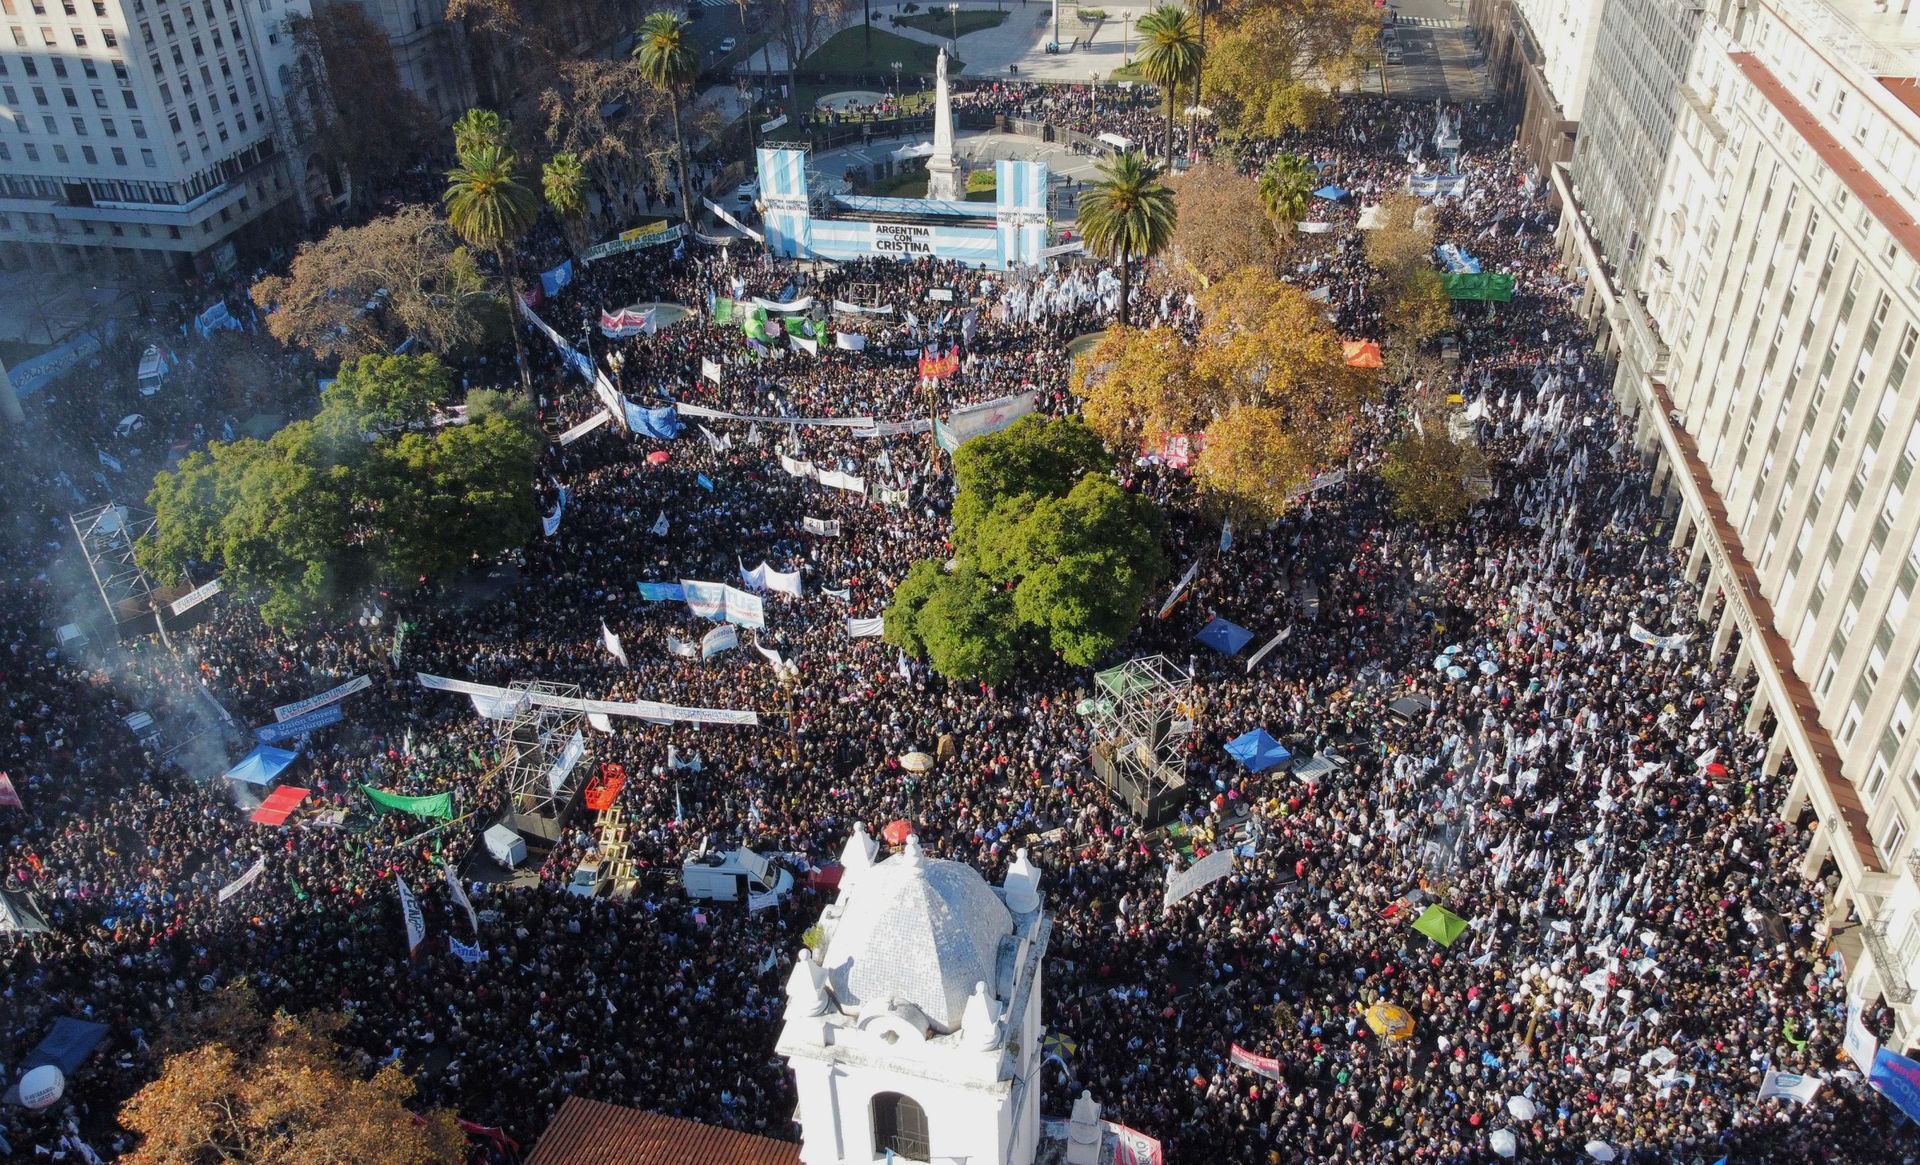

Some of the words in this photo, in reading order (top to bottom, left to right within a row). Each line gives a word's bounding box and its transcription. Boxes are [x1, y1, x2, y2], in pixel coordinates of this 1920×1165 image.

[643, 227, 679, 243] CRISTINA
[876, 225, 929, 237] ARGENTINA
[894, 234, 912, 242] CON
[876, 240, 930, 252] CRISTINA
[1698, 510, 1706, 529] LA
[1706, 528, 1724, 569] FRANCO
[1723, 572, 1753, 637] ARGENTINA
[280, 699, 312, 715] ¡FUERZA
[277, 717, 306, 731] Unión
[307, 707, 339, 723] Obrera
